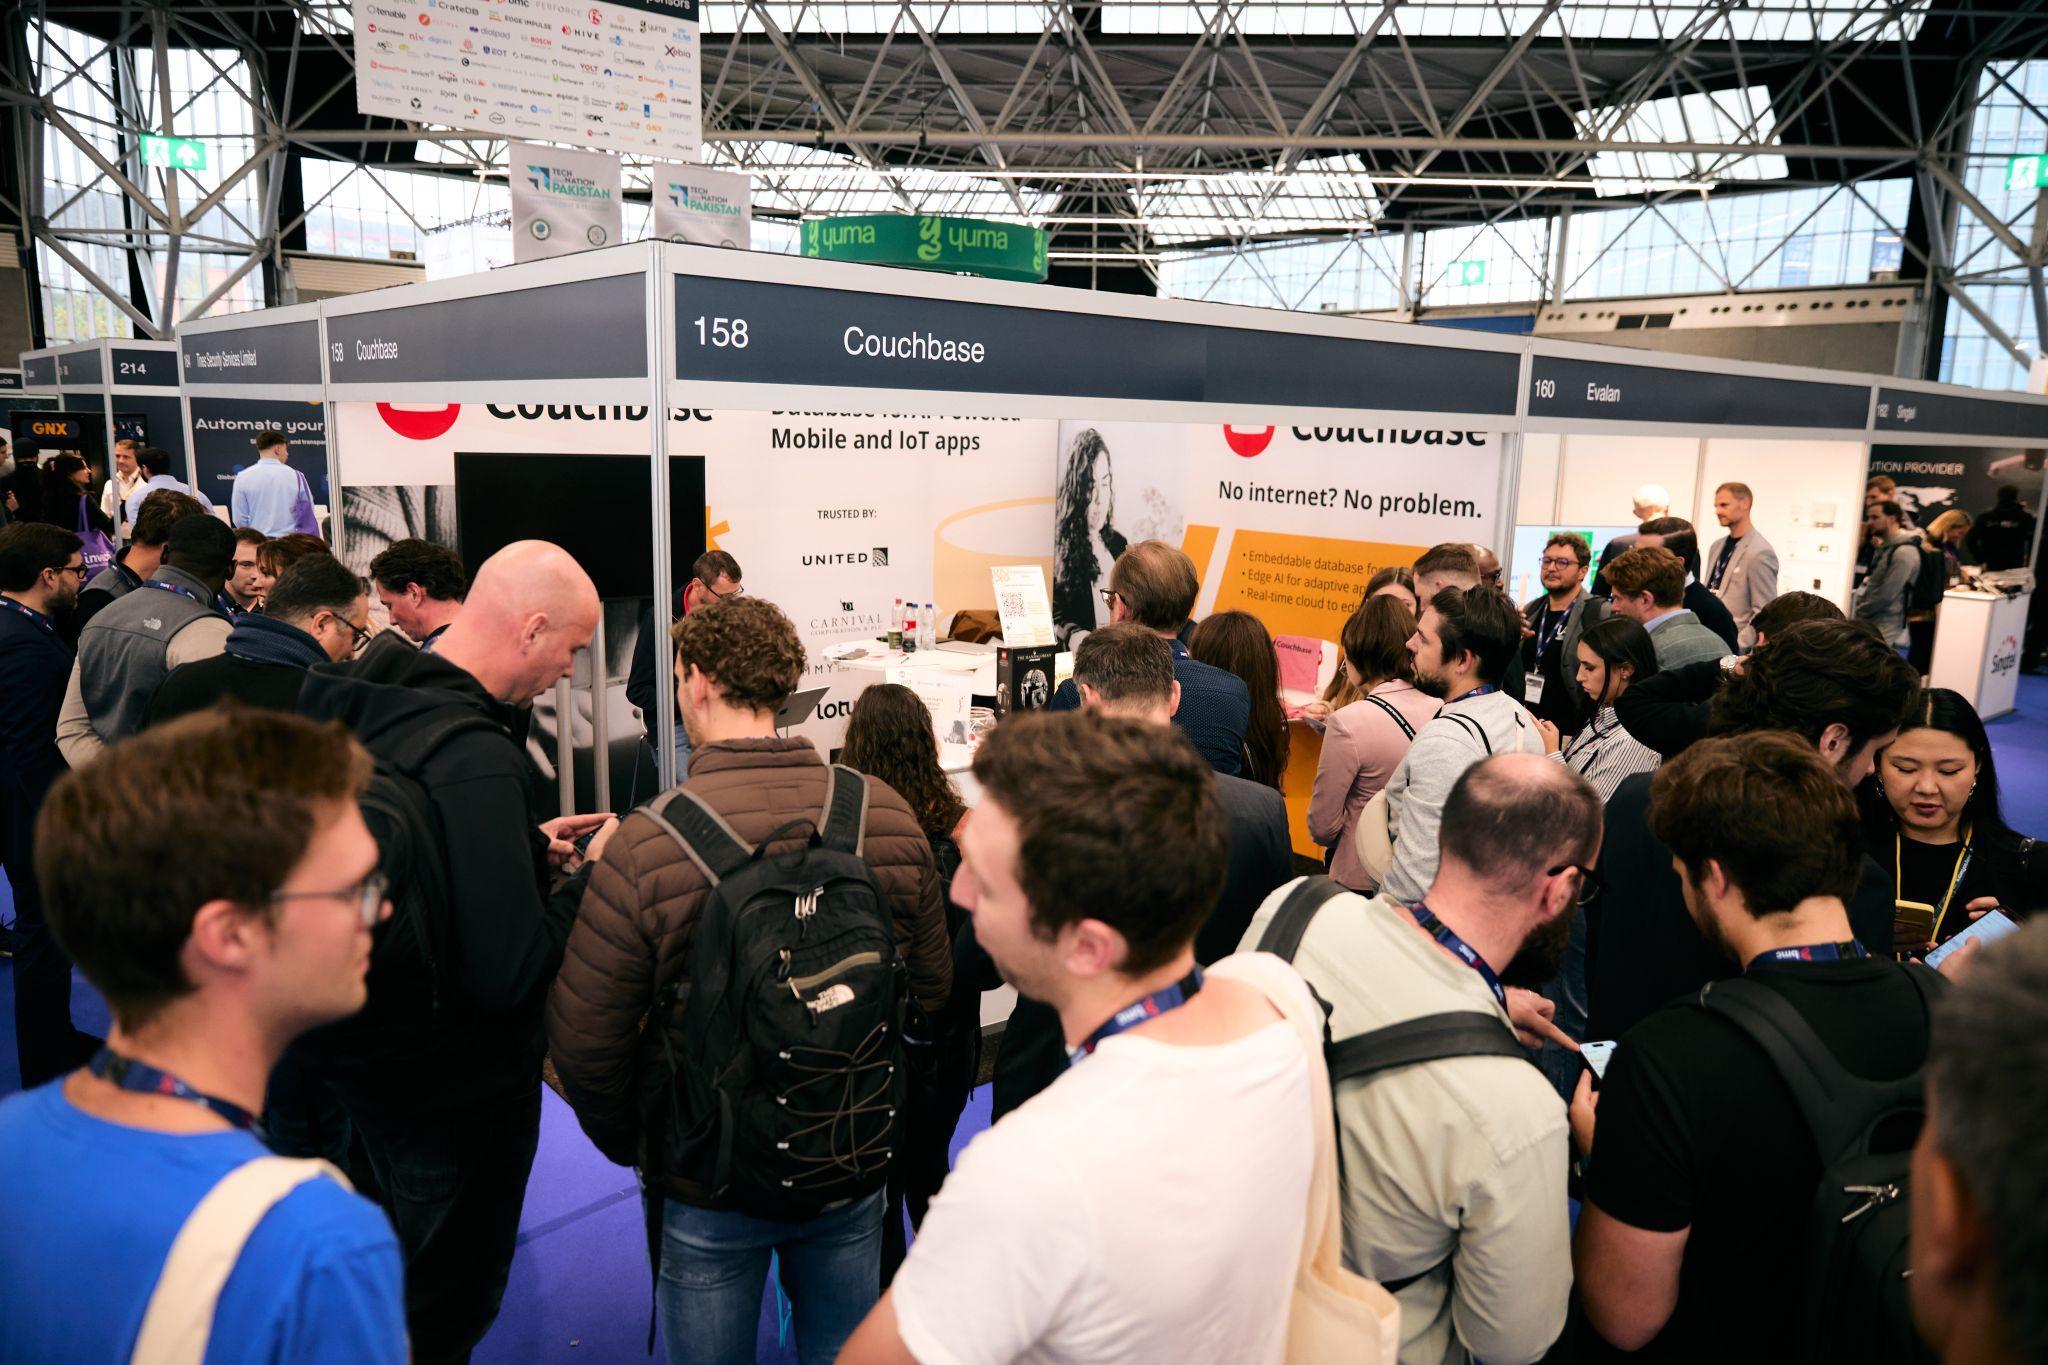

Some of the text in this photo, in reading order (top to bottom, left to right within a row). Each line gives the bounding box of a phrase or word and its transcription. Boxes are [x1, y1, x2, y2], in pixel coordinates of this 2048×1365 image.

[376, 7, 407, 20] tenable
[438, 2, 479, 16] CrateDB
[504, 15, 552, 30] EDGE IMPULSE
[530, 36, 552, 47] BOSCH
[574, 28, 600, 41] HIVE
[664, 44, 692, 59] Xebia
[580, 62, 599, 73] VOLT
[552, 168, 573, 177] TECH
[552, 182, 611, 199] PAKISTAN
[690, 186, 709, 195] TECH
[690, 201, 742, 216] PAKISTAN
[822, 224, 875, 252] yuma
[949, 227, 1008, 253] yuma
[694, 316, 985, 363] 158 Couchbase
[240, 348, 258, 367] Limited
[331, 339, 398, 363] 158 Couchbase
[120, 362, 147, 375] 214
[1534, 378, 1621, 404] 160 Evalan
[32, 422, 69, 436] GNX
[195, 417, 323, 434] Automate your
[772, 427, 981, 456] Mobile and IoT apps
[1903, 462, 1966, 476] PROVIDER
[1219, 480, 1483, 518] No internet? No problem.
[817, 508, 878, 520] TRUSTED BY:
[802, 552, 868, 566] UNITED
[1249, 550, 1312, 569] Embeddable
[1314, 557, 1364, 575] database
[1248, 568, 1272, 585] Edge
[1274, 573, 1284, 584] AI
[1286, 574, 1301, 586] for
[1303, 577, 1350, 593] adaptive
[1247, 587, 1294, 605] Real-time
[1295, 595, 1325, 610] cloud
[1327, 600, 1338, 611] to
[810, 613, 883, 630] CARNIVAL
[1276, 640, 1312, 654] Couchbase
[1991, 653, 2016, 676] Singtel
[817, 701, 855, 720] lot
[1775, 949, 1800, 960] bmc
